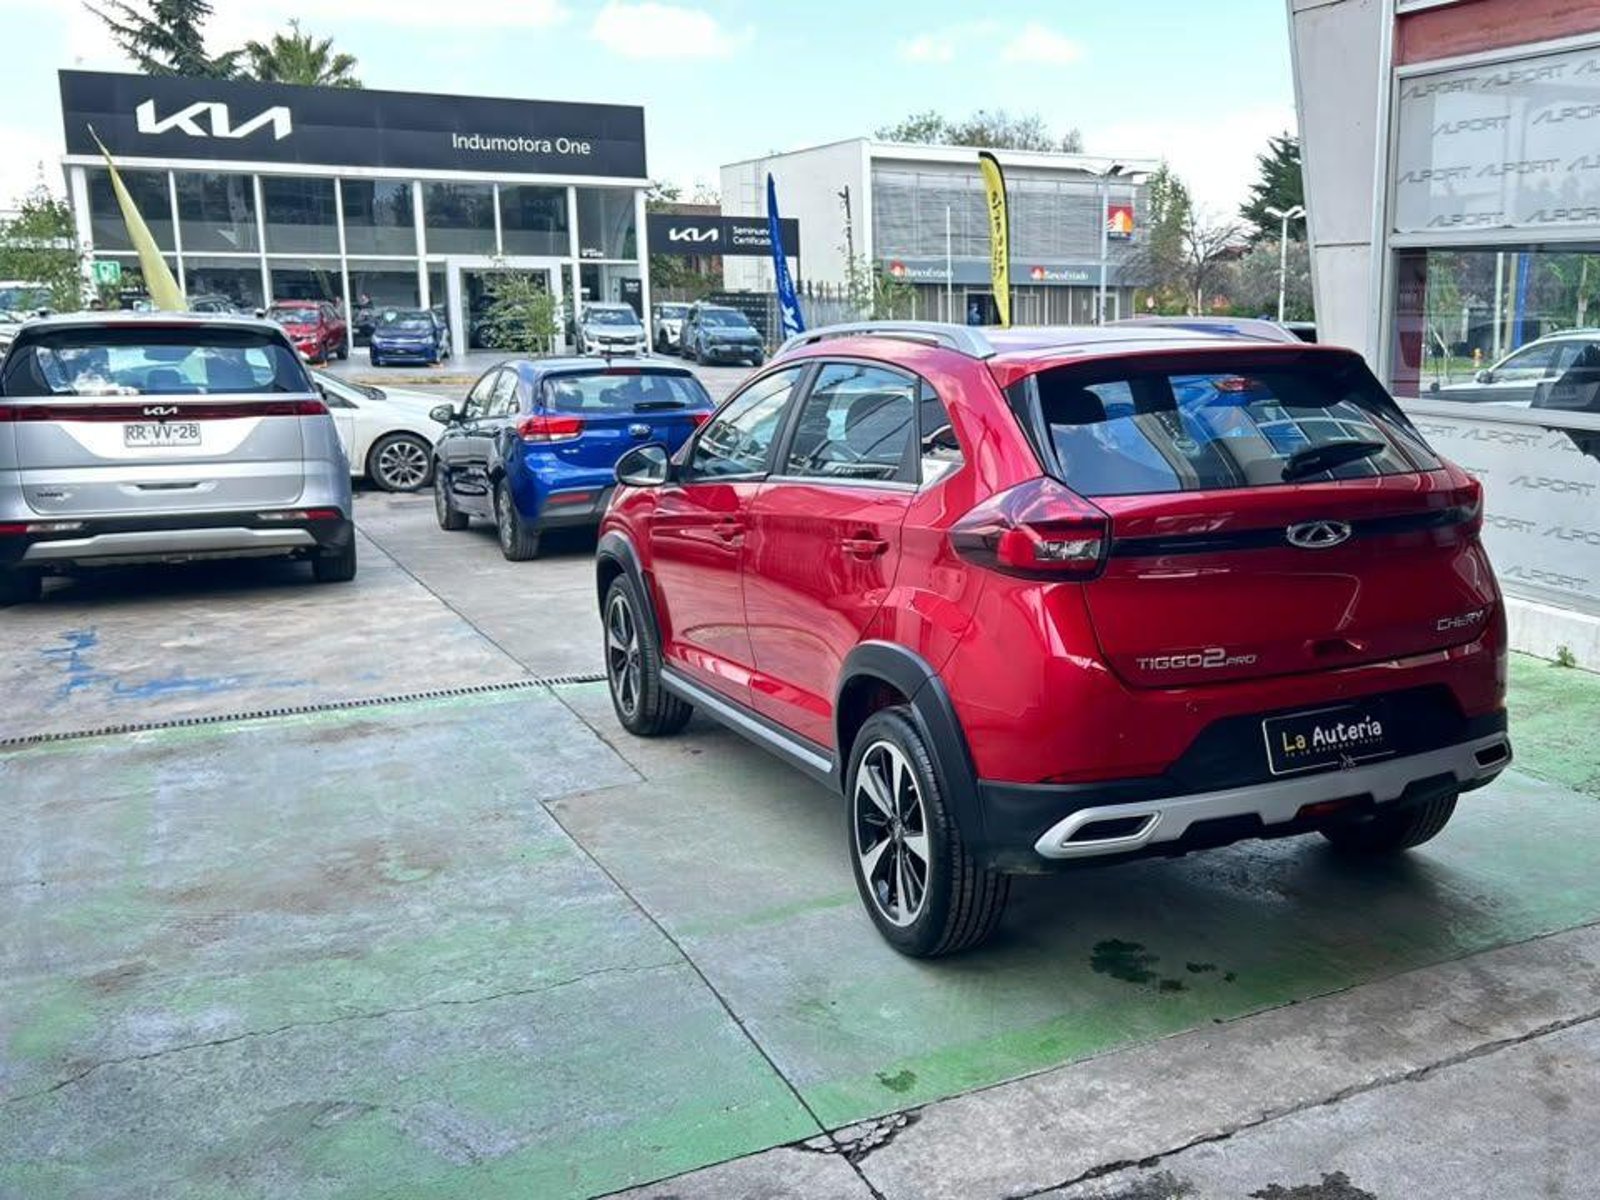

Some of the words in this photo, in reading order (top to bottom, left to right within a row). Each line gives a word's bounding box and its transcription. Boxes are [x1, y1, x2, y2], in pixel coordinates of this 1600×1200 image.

[136, 99, 293, 141] KIA
[1532, 105, 1600, 126] ALPOR
[452, 132, 551, 153] Indumotora
[555, 137, 591, 155] One
[1524, 206, 1600, 224] ALPOR
[668, 227, 719, 242] KIA
[732, 225, 771, 236] Seminuev
[143, 406, 178, 416] KIA
[1437, 609, 1484, 631] CHERY
[1282, 731, 1306, 752] La
[1312, 714, 1383, 747] Autería
